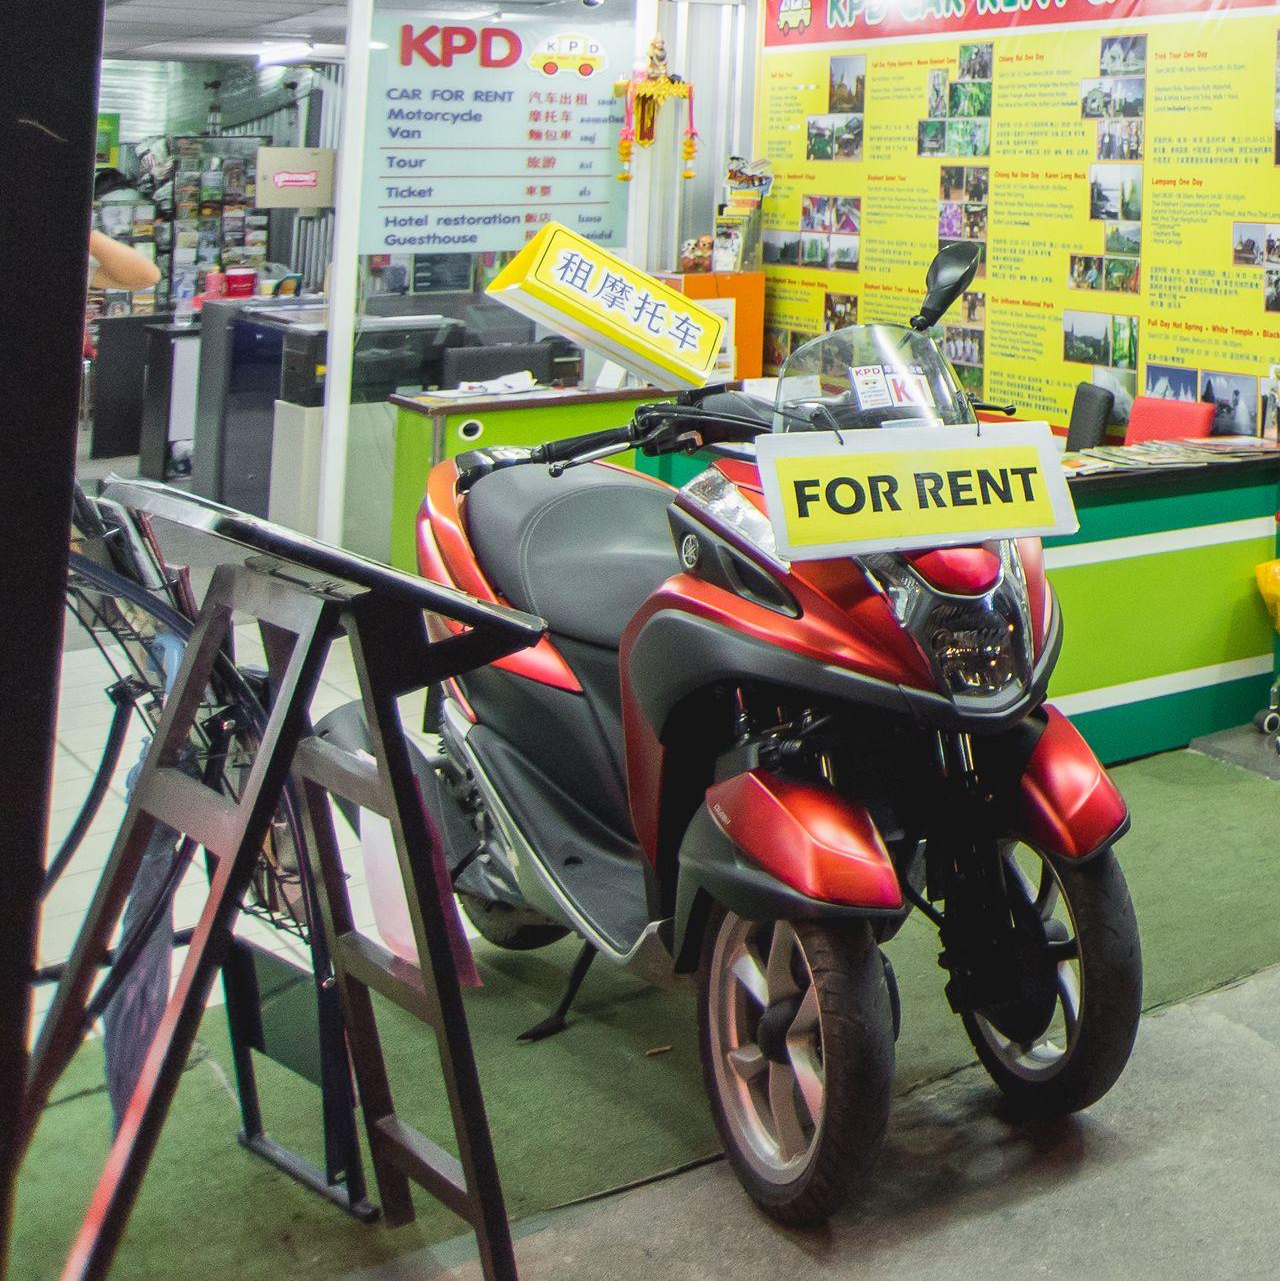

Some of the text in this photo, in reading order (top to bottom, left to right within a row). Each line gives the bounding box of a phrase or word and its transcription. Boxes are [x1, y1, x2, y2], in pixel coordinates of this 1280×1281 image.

[399, 24, 523, 68] KPD
[386, 88, 515, 103] CAR FOR RENT
[387, 109, 483, 123] Motorcycle
[388, 126, 422, 139] Van
[387, 156, 425, 169] Tour
[1152, 178, 1176, 187] Lampang
[1192, 179, 1203, 187] Day
[386, 185, 433, 199] Ticket
[384, 213, 521, 228] Hotel restoration
[384, 232, 478, 247] Guesthouse
[556, 252, 702, 350] 租摩托车
[1263, 329, 1280, 339] Black
[854, 366, 881, 377] KPD
[793, 466, 1037, 519] FOR RENT
